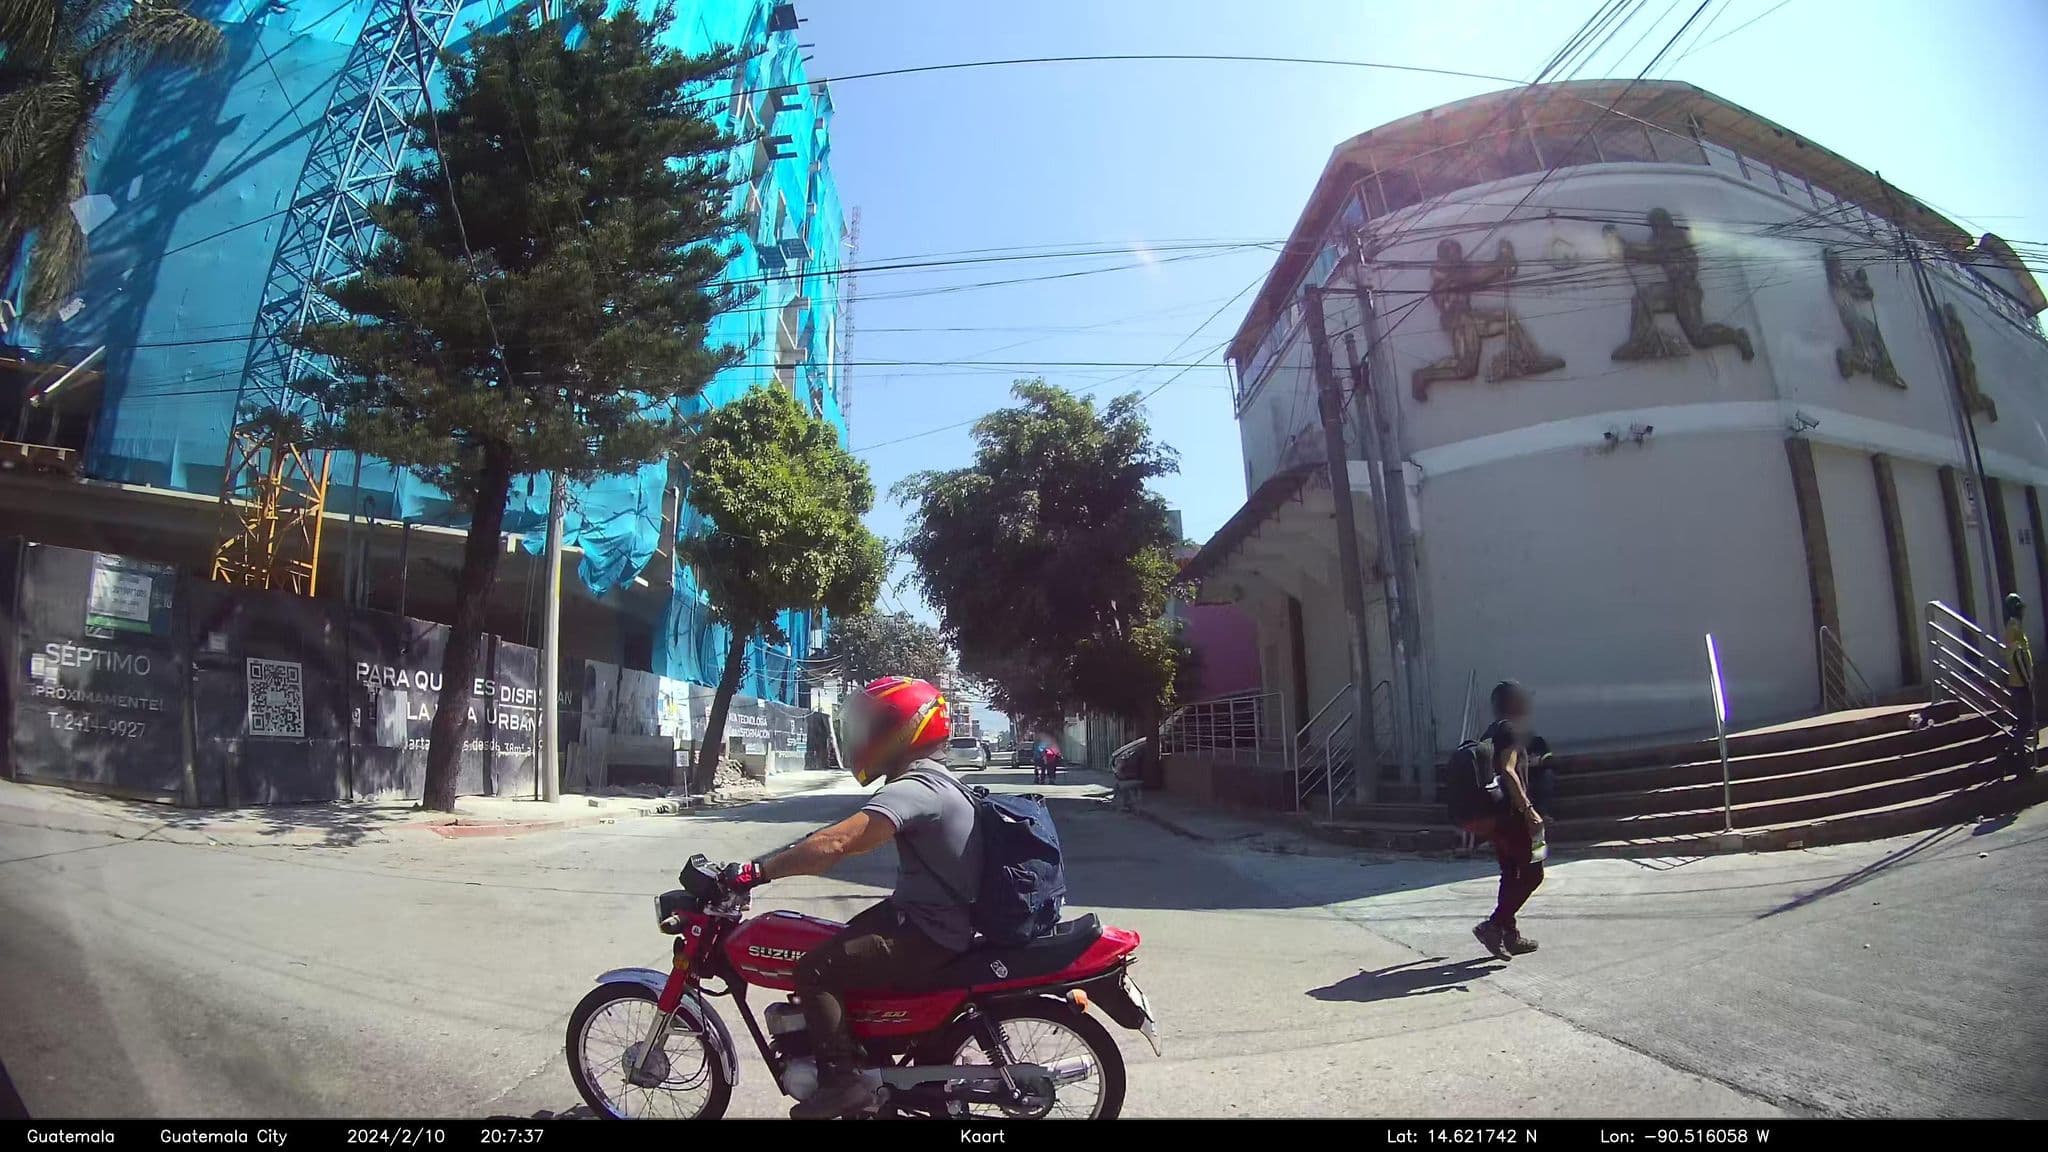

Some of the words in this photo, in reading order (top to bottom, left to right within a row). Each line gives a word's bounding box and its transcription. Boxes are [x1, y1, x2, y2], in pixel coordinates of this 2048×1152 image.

[45, 640, 152, 676] SÉPTIMO
[356, 662, 410, 688] PARA
[406, 702, 431, 721] LA
[748, 945, 808, 962] SUZUK
